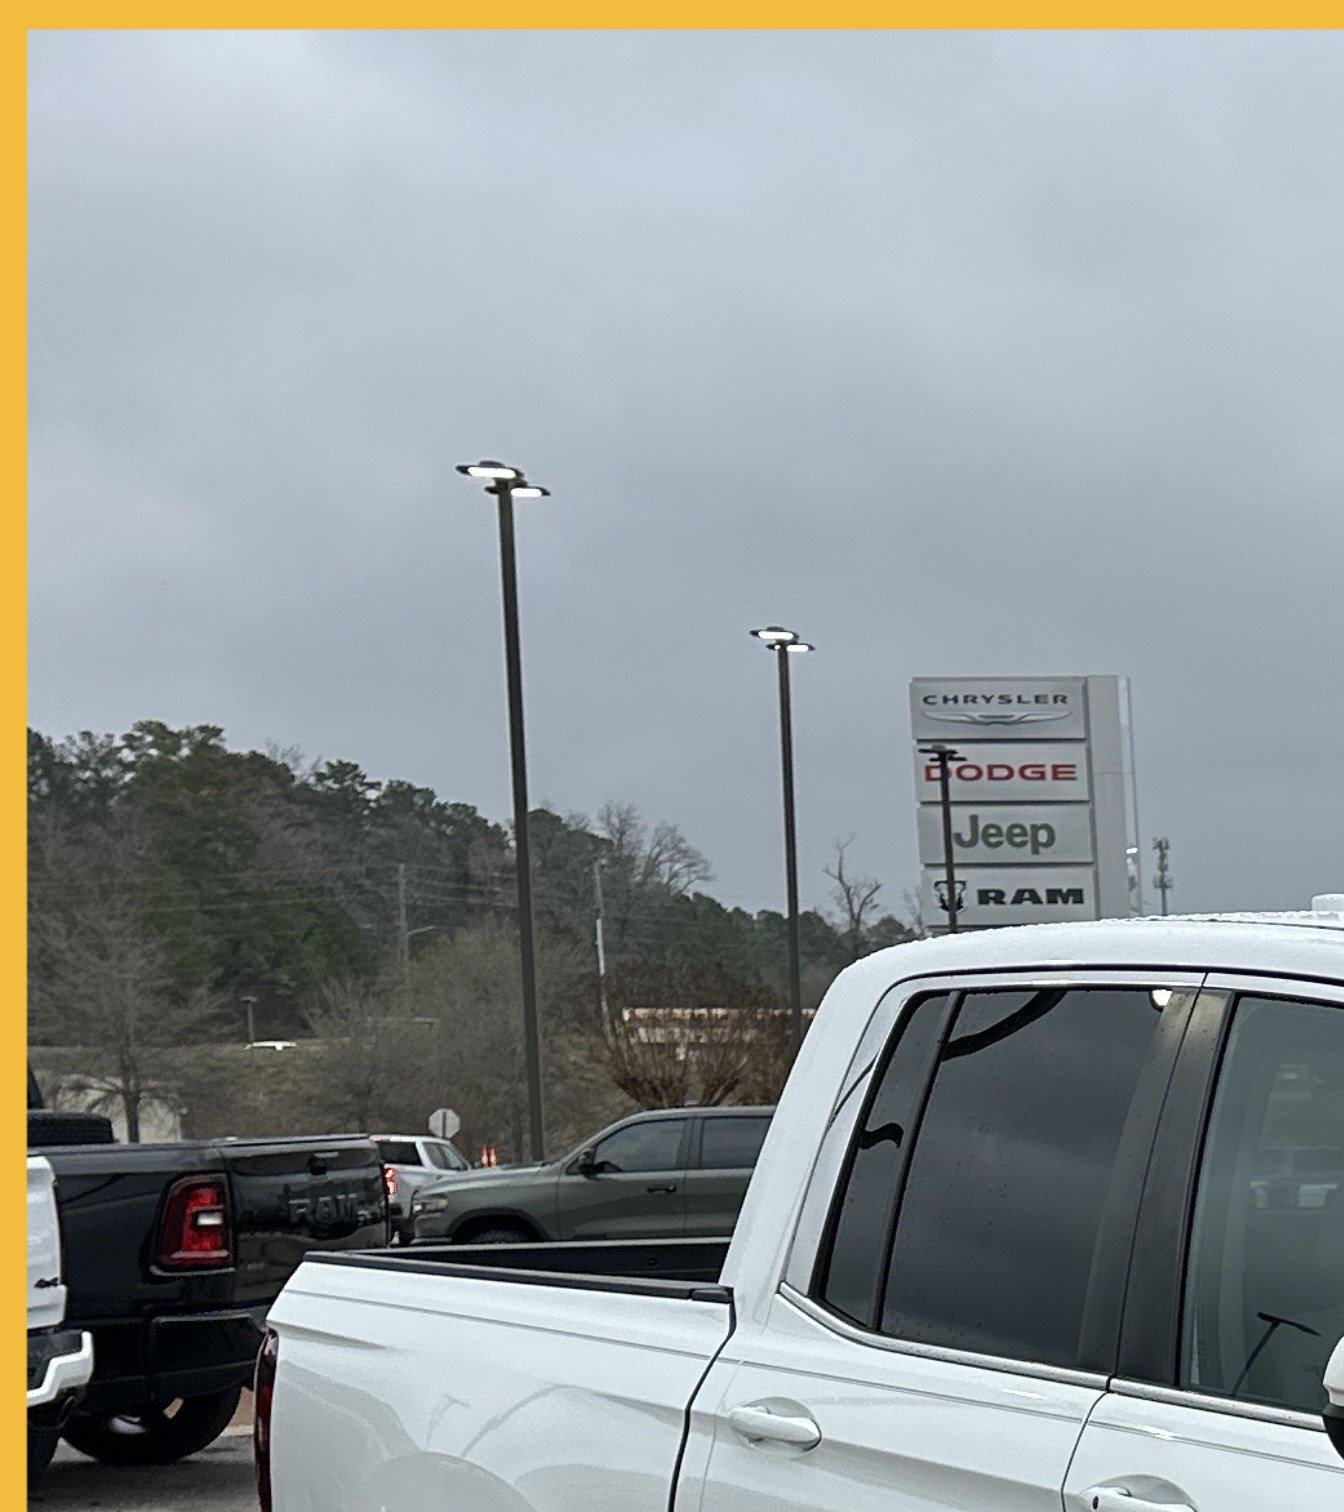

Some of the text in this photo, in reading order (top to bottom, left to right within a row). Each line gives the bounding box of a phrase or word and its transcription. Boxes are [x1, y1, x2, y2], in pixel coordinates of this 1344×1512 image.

[922, 693, 1069, 706] CHRYSLER
[924, 763, 1078, 782] DODGE
[953, 814, 1056, 854] Jeep
[976, 888, 1085, 906] RAM
[288, 1192, 358, 1222] RAM
